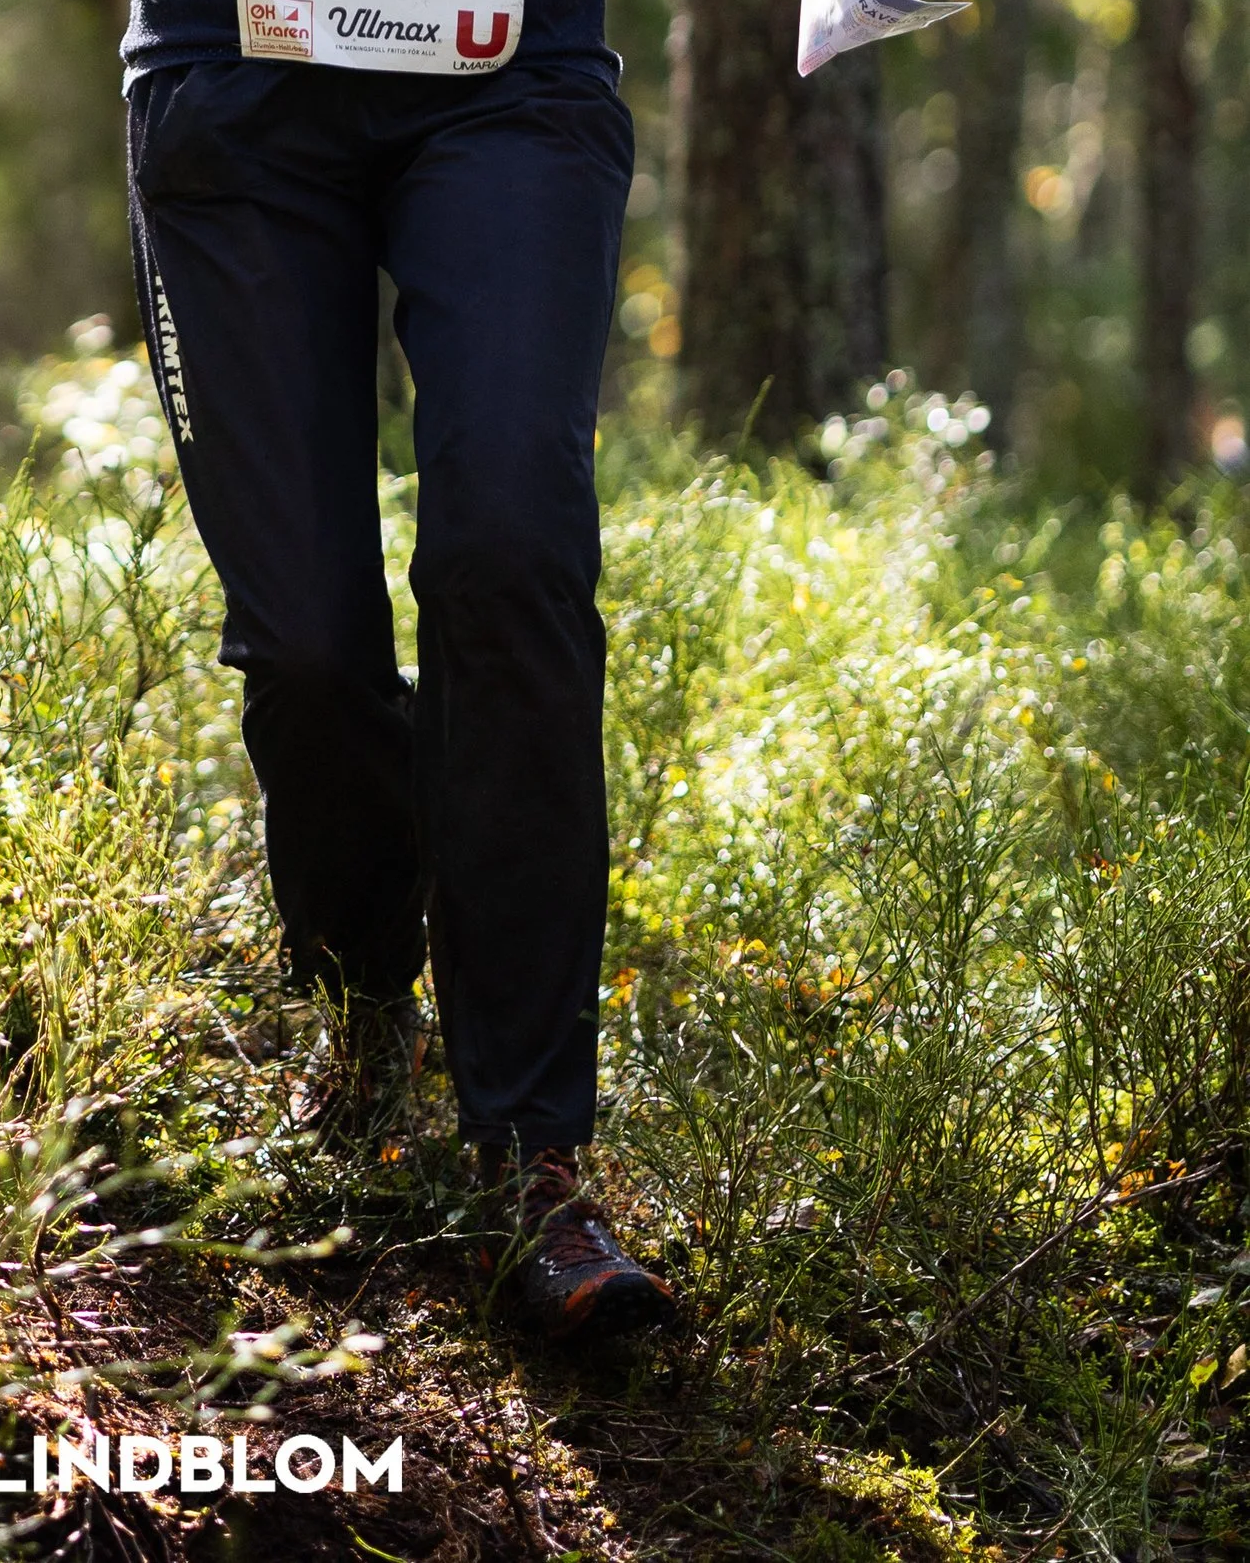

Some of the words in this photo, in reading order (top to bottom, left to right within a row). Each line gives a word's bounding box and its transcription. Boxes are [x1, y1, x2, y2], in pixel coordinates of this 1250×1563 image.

[252, 21, 309, 38] Tisaren
[328, 7, 440, 42] Ullmax
[345, 45, 385, 53] MENINGSFULL
[453, 60, 499, 70] UMARA
